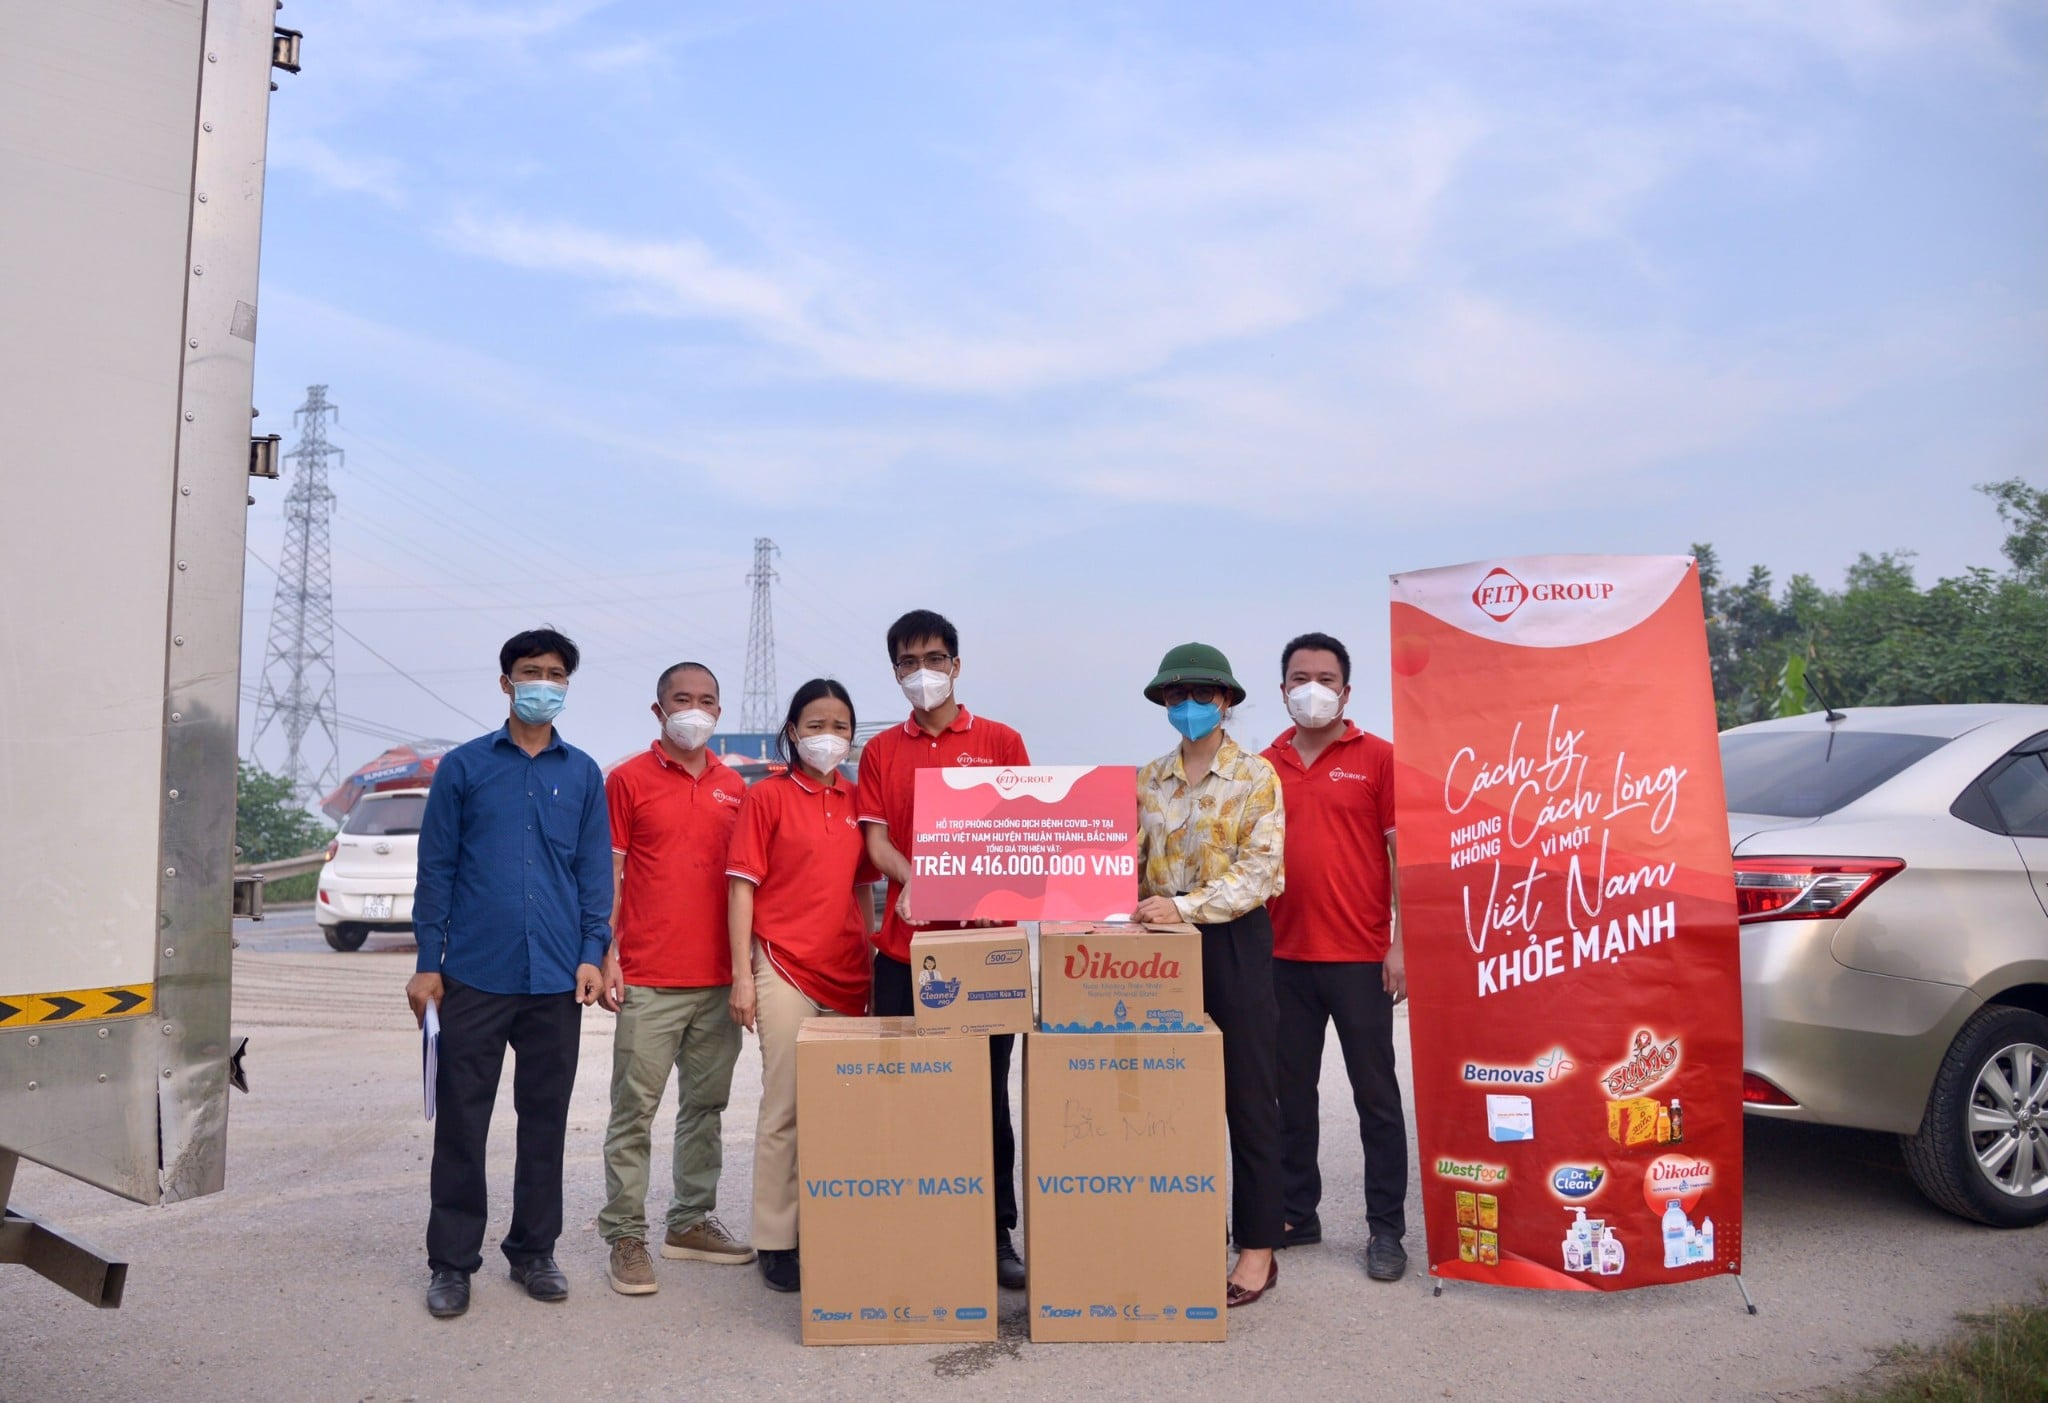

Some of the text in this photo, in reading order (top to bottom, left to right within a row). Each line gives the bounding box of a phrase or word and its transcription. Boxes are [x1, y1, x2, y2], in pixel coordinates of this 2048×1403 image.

[1532, 583, 1614, 601] GROUP
[1445, 721, 1535, 814] Cách
[1020, 775, 1053, 784] GROUP
[1509, 756, 1602, 848] Cách
[1064, 818, 1101, 828] COVID-19
[1450, 816, 1502, 848] NHƯNG
[971, 832, 990, 842] NAM
[1106, 832, 1128, 842] NINH
[1540, 826, 1592, 857] VÌ MỘT
[913, 851, 1135, 876] TRÊN 416.000.000 VNĐ
[1450, 838, 1502, 870] KHÔNG
[1463, 829, 1676, 954] Việt Nam
[991, 954, 1006, 962] 500
[1477, 901, 1676, 998] KHỎE MẠNH
[1064, 944, 1179, 980] Vikoda
[920, 991, 955, 1001] Cleanex
[836, 1061, 953, 1075] N95 FACE MASK
[1069, 1058, 1186, 1071] N95 FACE MASK
[1464, 1063, 1545, 1084] Benovas
[1437, 1160, 1508, 1181] Westfood
[1570, 1170, 1584, 1180] Dr
[1652, 1161, 1710, 1181] Vikoda
[918, 1177, 985, 1196] MASK
[1149, 1175, 1216, 1193] MASK
[1555, 1178, 1594, 1190] Clean
